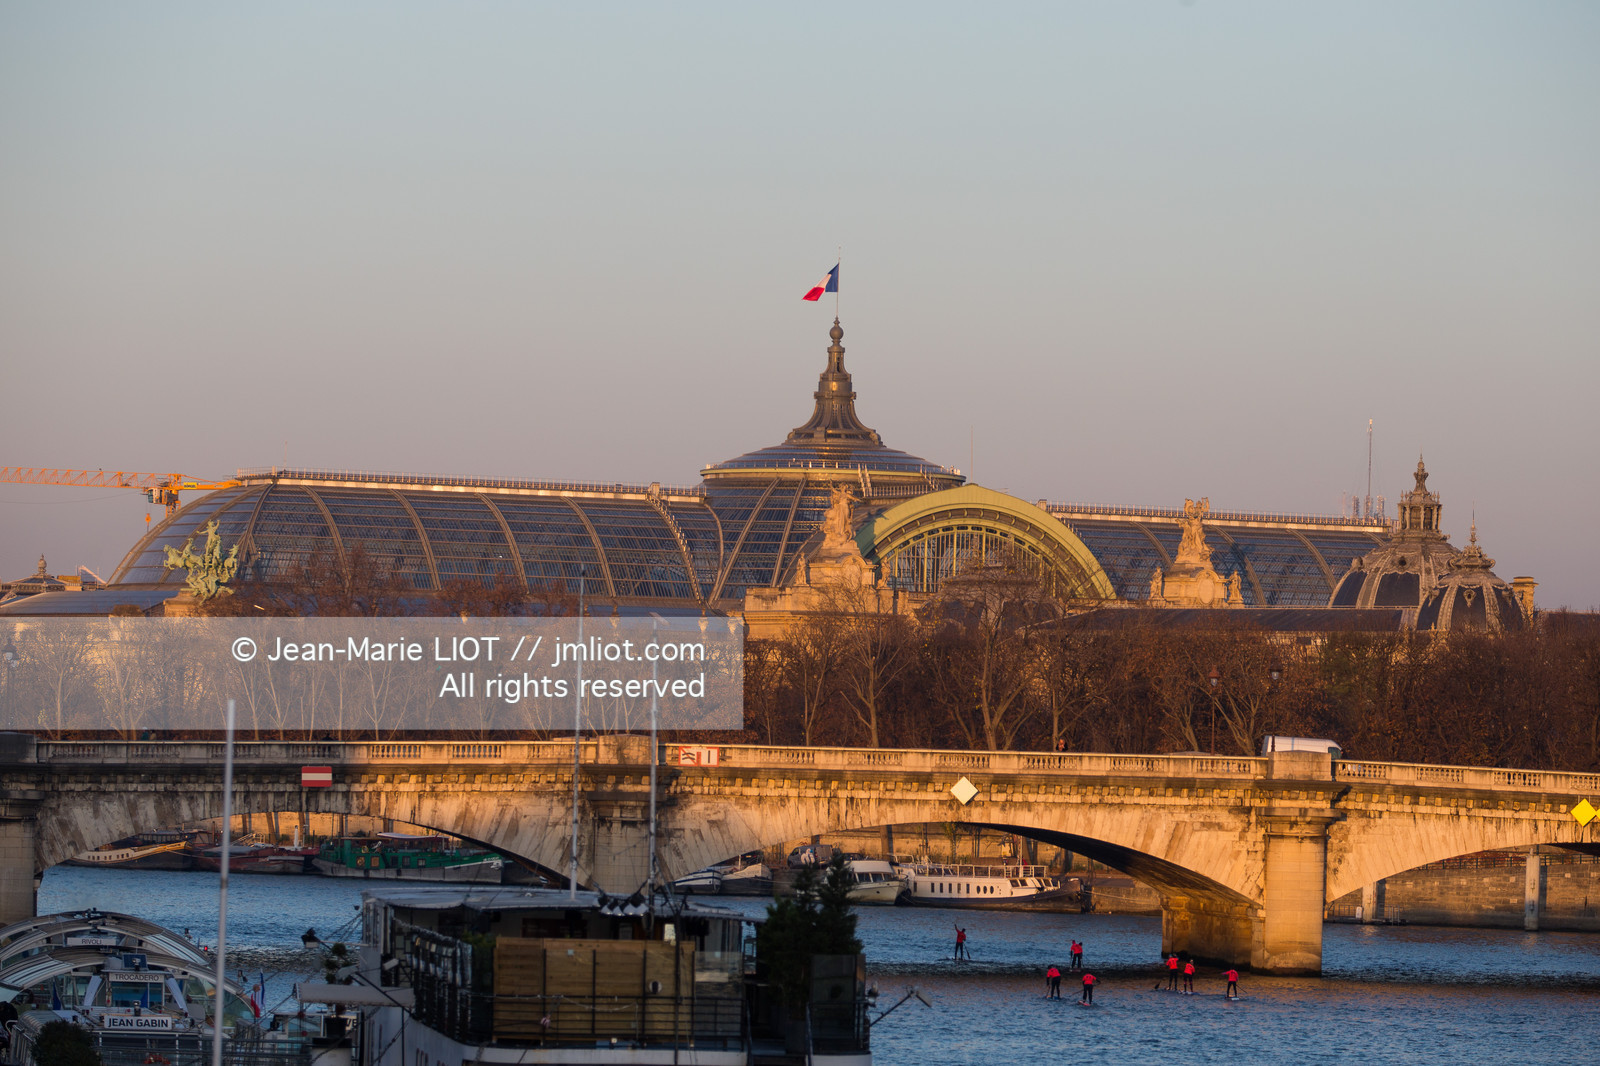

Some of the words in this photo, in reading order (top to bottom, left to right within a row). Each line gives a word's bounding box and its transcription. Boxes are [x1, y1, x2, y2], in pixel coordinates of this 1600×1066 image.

[115, 973, 160, 982] TROCADERO
[108, 1018, 133, 1028] JEAN
[136, 1018, 168, 1028] GABIN
